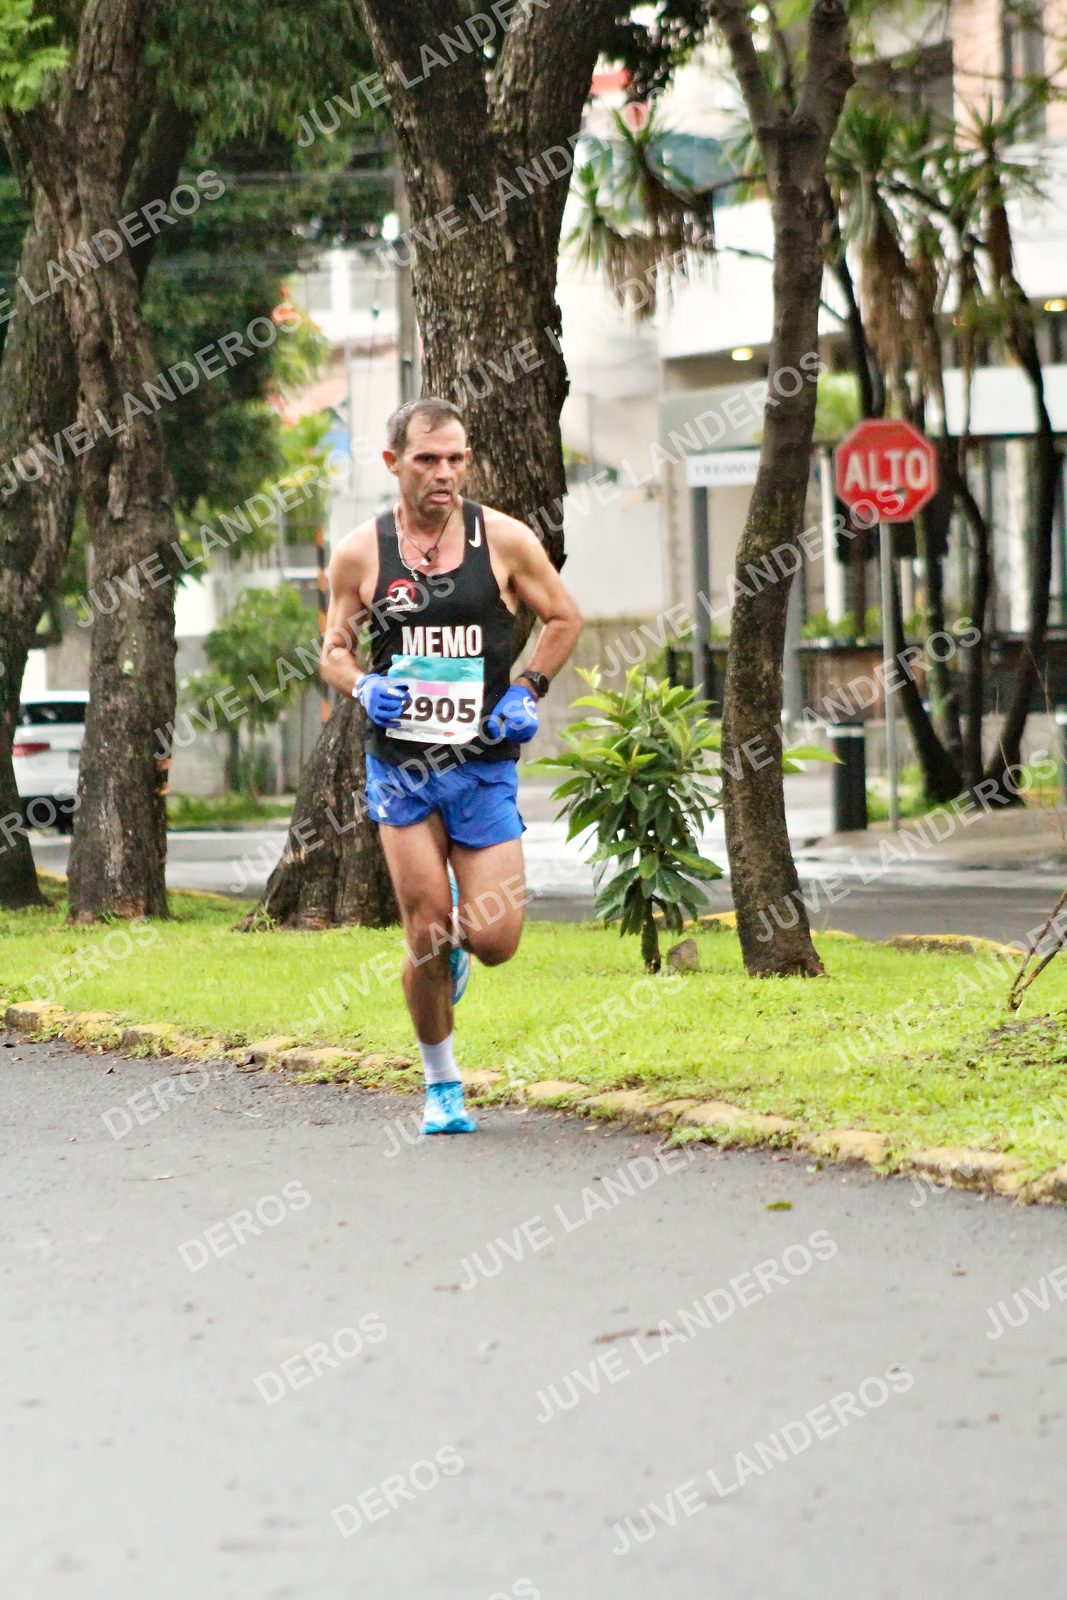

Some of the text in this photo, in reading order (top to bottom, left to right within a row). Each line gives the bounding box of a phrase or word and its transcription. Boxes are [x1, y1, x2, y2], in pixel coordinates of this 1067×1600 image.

[843, 448, 928, 492] ALTO
[401, 624, 482, 657] MEMO
[401, 696, 477, 723] 2905
